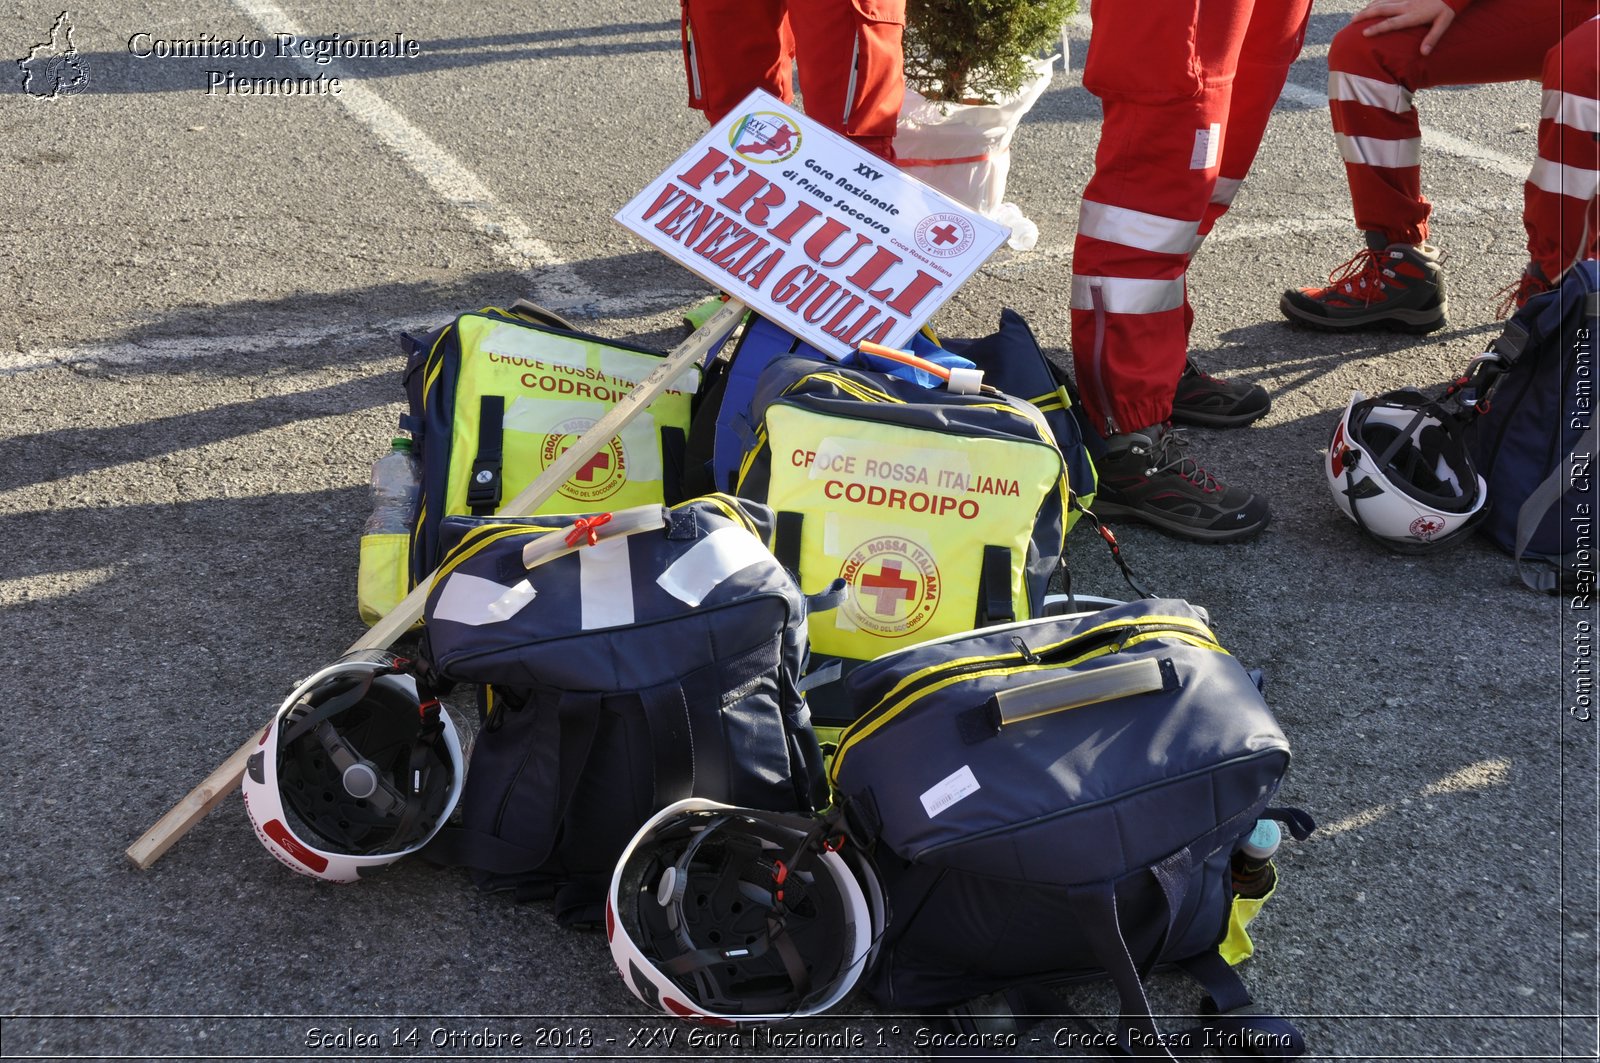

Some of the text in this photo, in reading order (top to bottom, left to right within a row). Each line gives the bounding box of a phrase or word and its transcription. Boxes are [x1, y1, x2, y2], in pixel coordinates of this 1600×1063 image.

[804, 159, 900, 216] Gara Nazionale
[852, 162, 884, 181] XXV
[782, 170, 890, 234] di Primo Soccorso
[676, 147, 944, 318] FRIULI
[890, 238, 952, 278] Croce Rossa Italiana
[642, 182, 898, 349] VENEZIA GIULIA
[791, 450, 1020, 497] CROCE ROSSA ITALIANA
[824, 480, 980, 520] CODROIPO
[868, 540, 908, 554] ROSSA
[912, 549, 936, 600] ITALIANA
[894, 612, 924, 632] SOCCORSO
